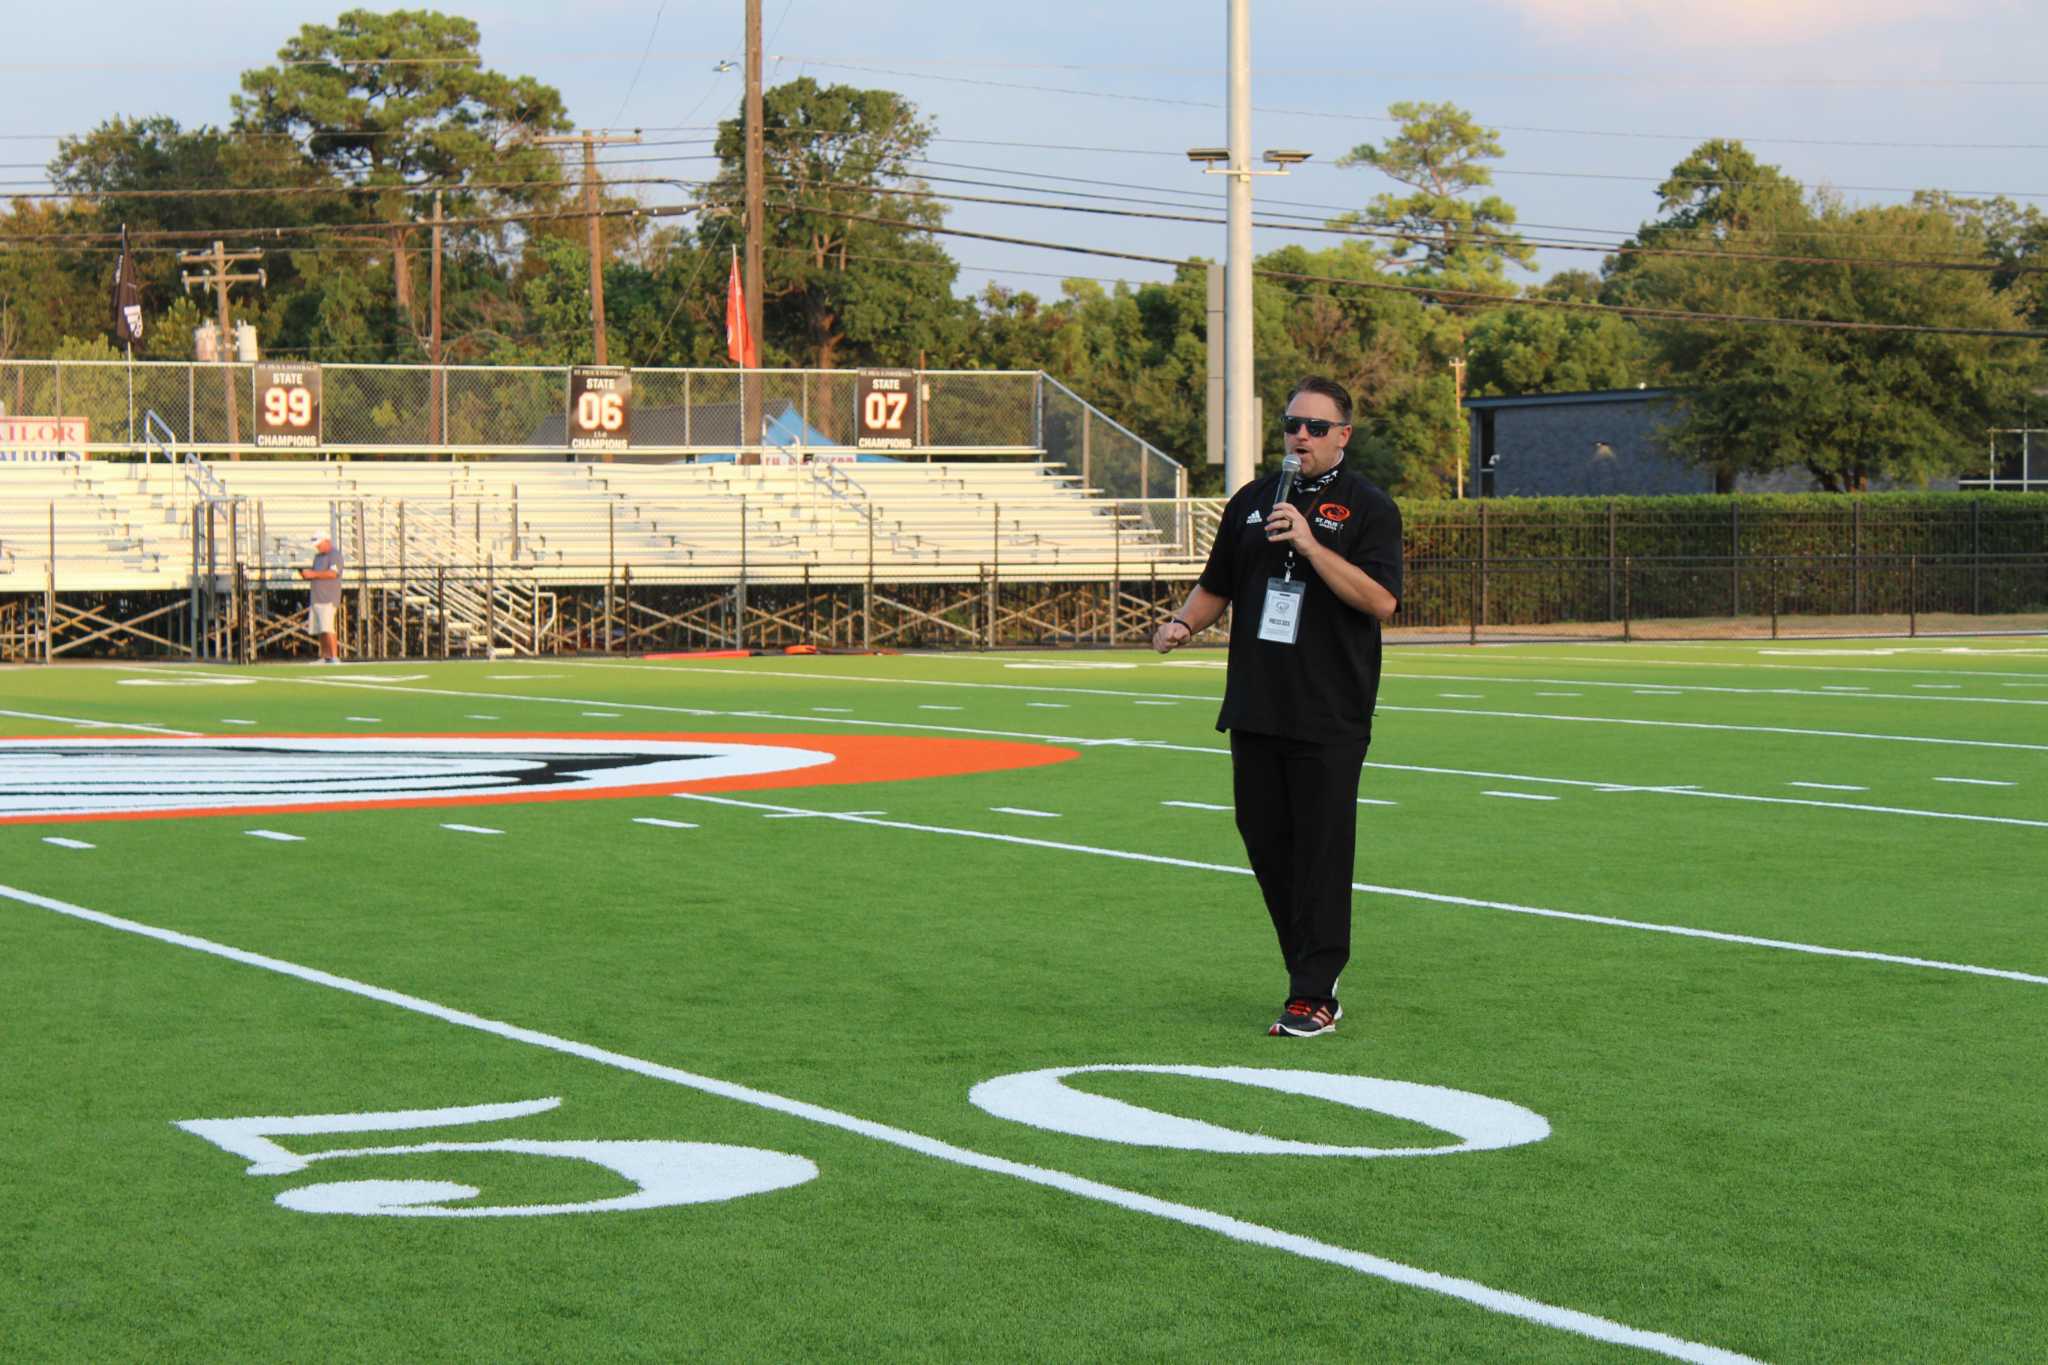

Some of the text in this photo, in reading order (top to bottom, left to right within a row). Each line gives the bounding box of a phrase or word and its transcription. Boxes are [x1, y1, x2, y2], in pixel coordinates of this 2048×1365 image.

[272, 373, 303, 385] STATE
[586, 378, 615, 390] STATE
[872, 379, 901, 390] STATE
[264, 387, 312, 426] 99
[578, 392, 623, 431] 06
[865, 392, 908, 430] 07
[0, 426, 76, 441] ILOR
[257, 434, 317, 447] CHAMPIONS
[572, 438, 628, 449] CHAMPIONS
[858, 437, 912, 448] CHAMPIONS
